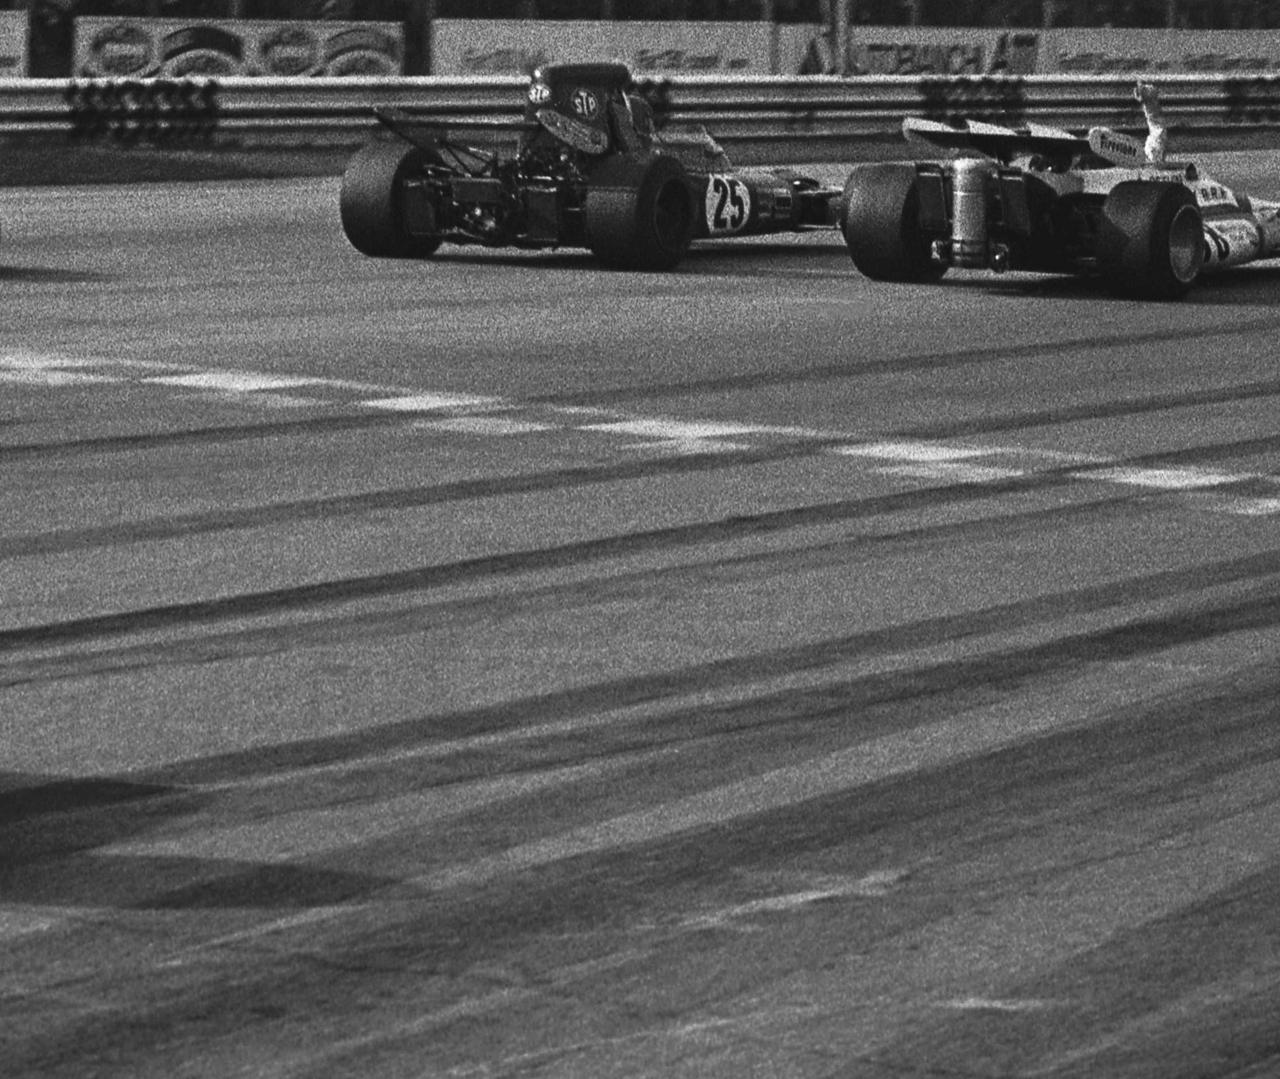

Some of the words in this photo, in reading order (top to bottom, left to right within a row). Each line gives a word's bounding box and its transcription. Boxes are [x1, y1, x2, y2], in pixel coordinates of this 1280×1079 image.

[528, 83, 551, 102] STP
[573, 90, 597, 116] STP
[712, 177, 745, 230] 25
